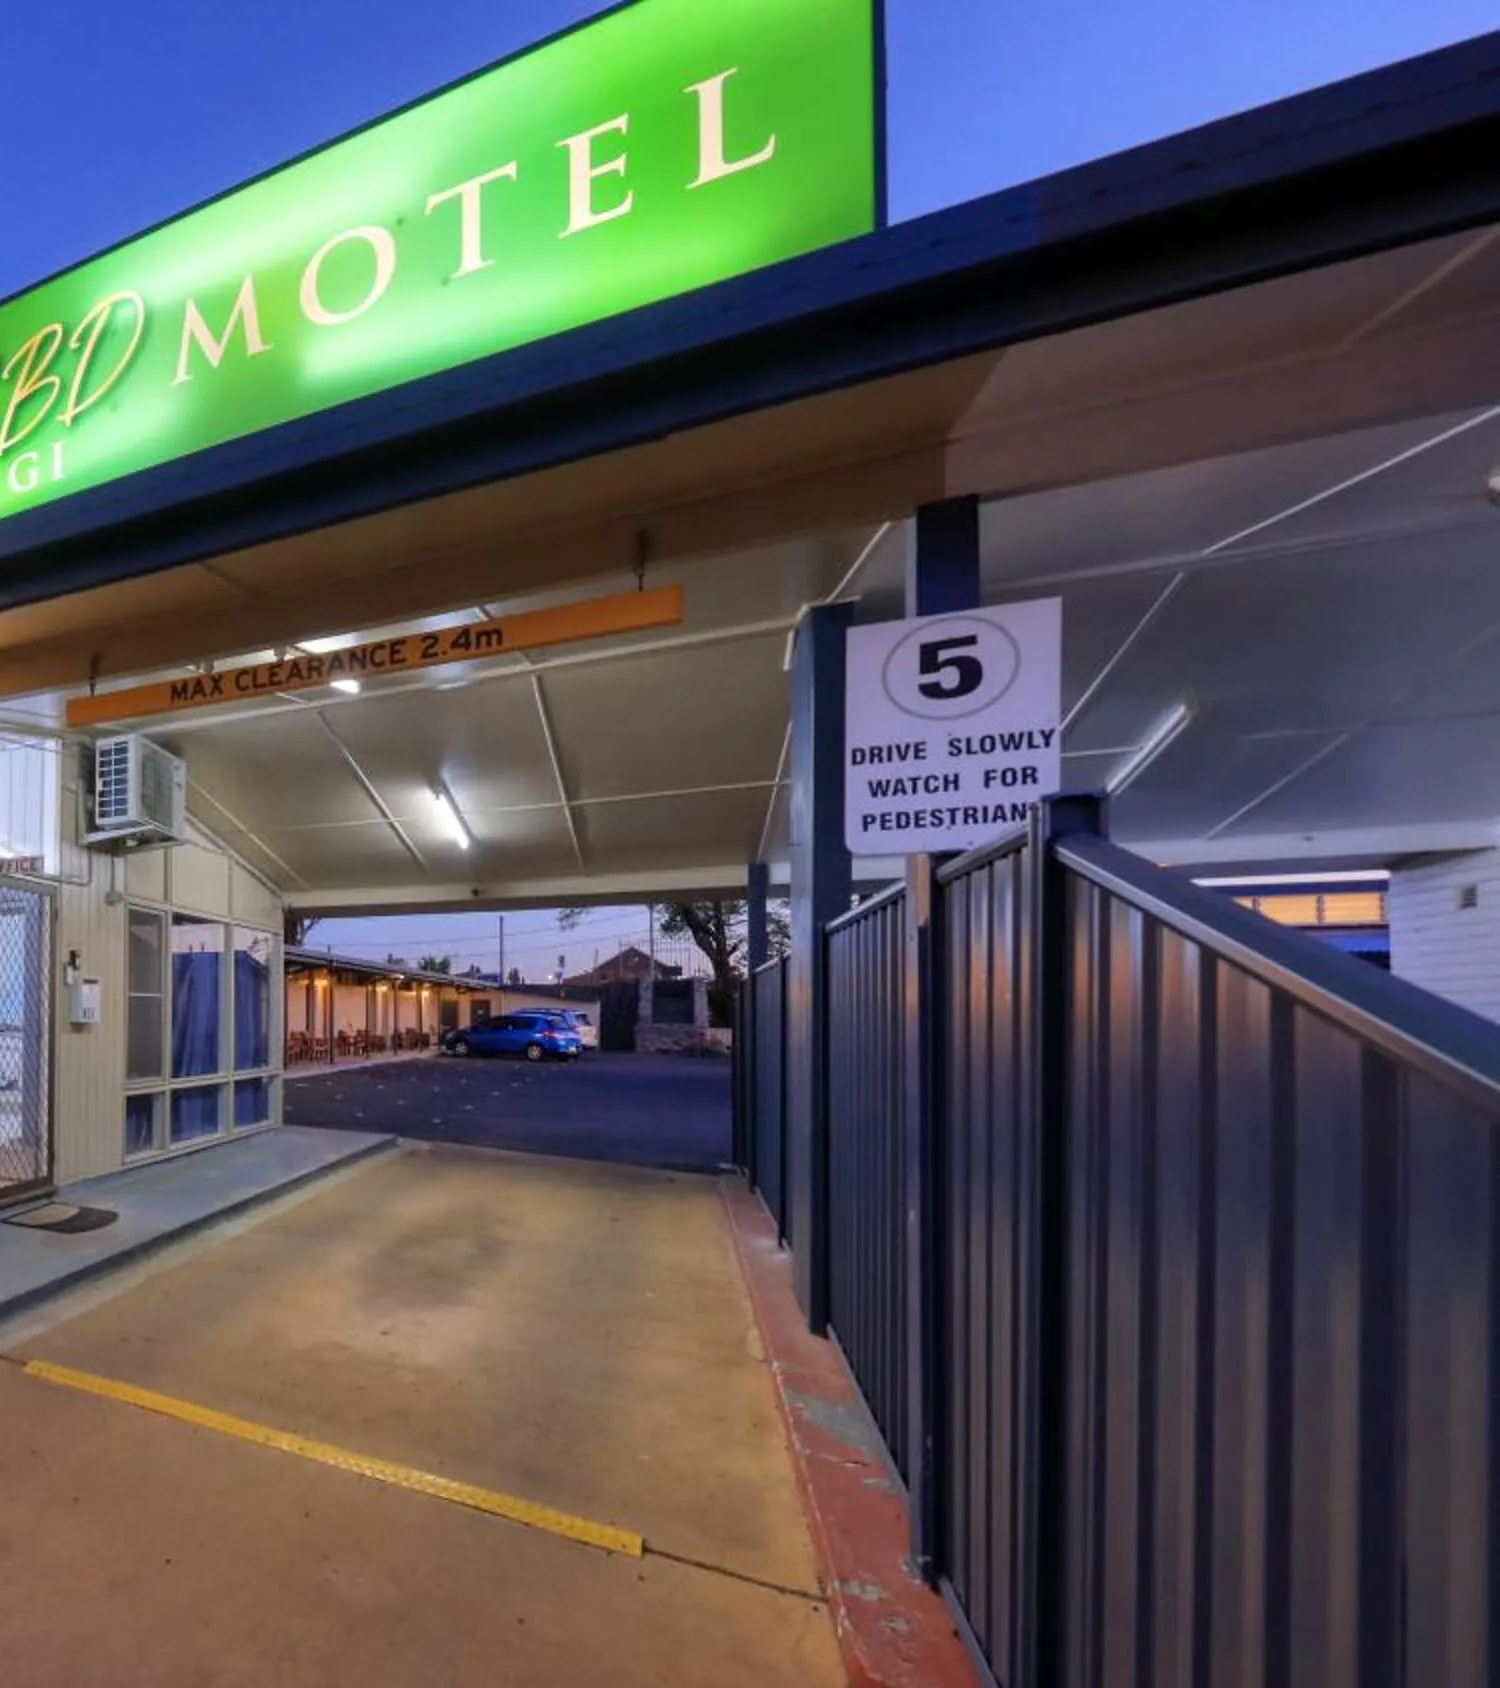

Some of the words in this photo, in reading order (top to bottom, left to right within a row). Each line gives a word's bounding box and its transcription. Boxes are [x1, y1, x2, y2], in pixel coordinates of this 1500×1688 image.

[171, 67, 776, 386] MOTEL
[169, 671, 224, 704] MAX
[235, 640, 407, 692] CLEARANCE
[420, 626, 504, 660] 2.4m
[917, 634, 984, 700] 5
[851, 741, 928, 766] DRIVE
[948, 728, 1056, 757] SLOWLY
[868, 773, 960, 798] WATCH
[983, 766, 1039, 789] FOR
[861, 802, 1039, 832] PEDESTRIAN
